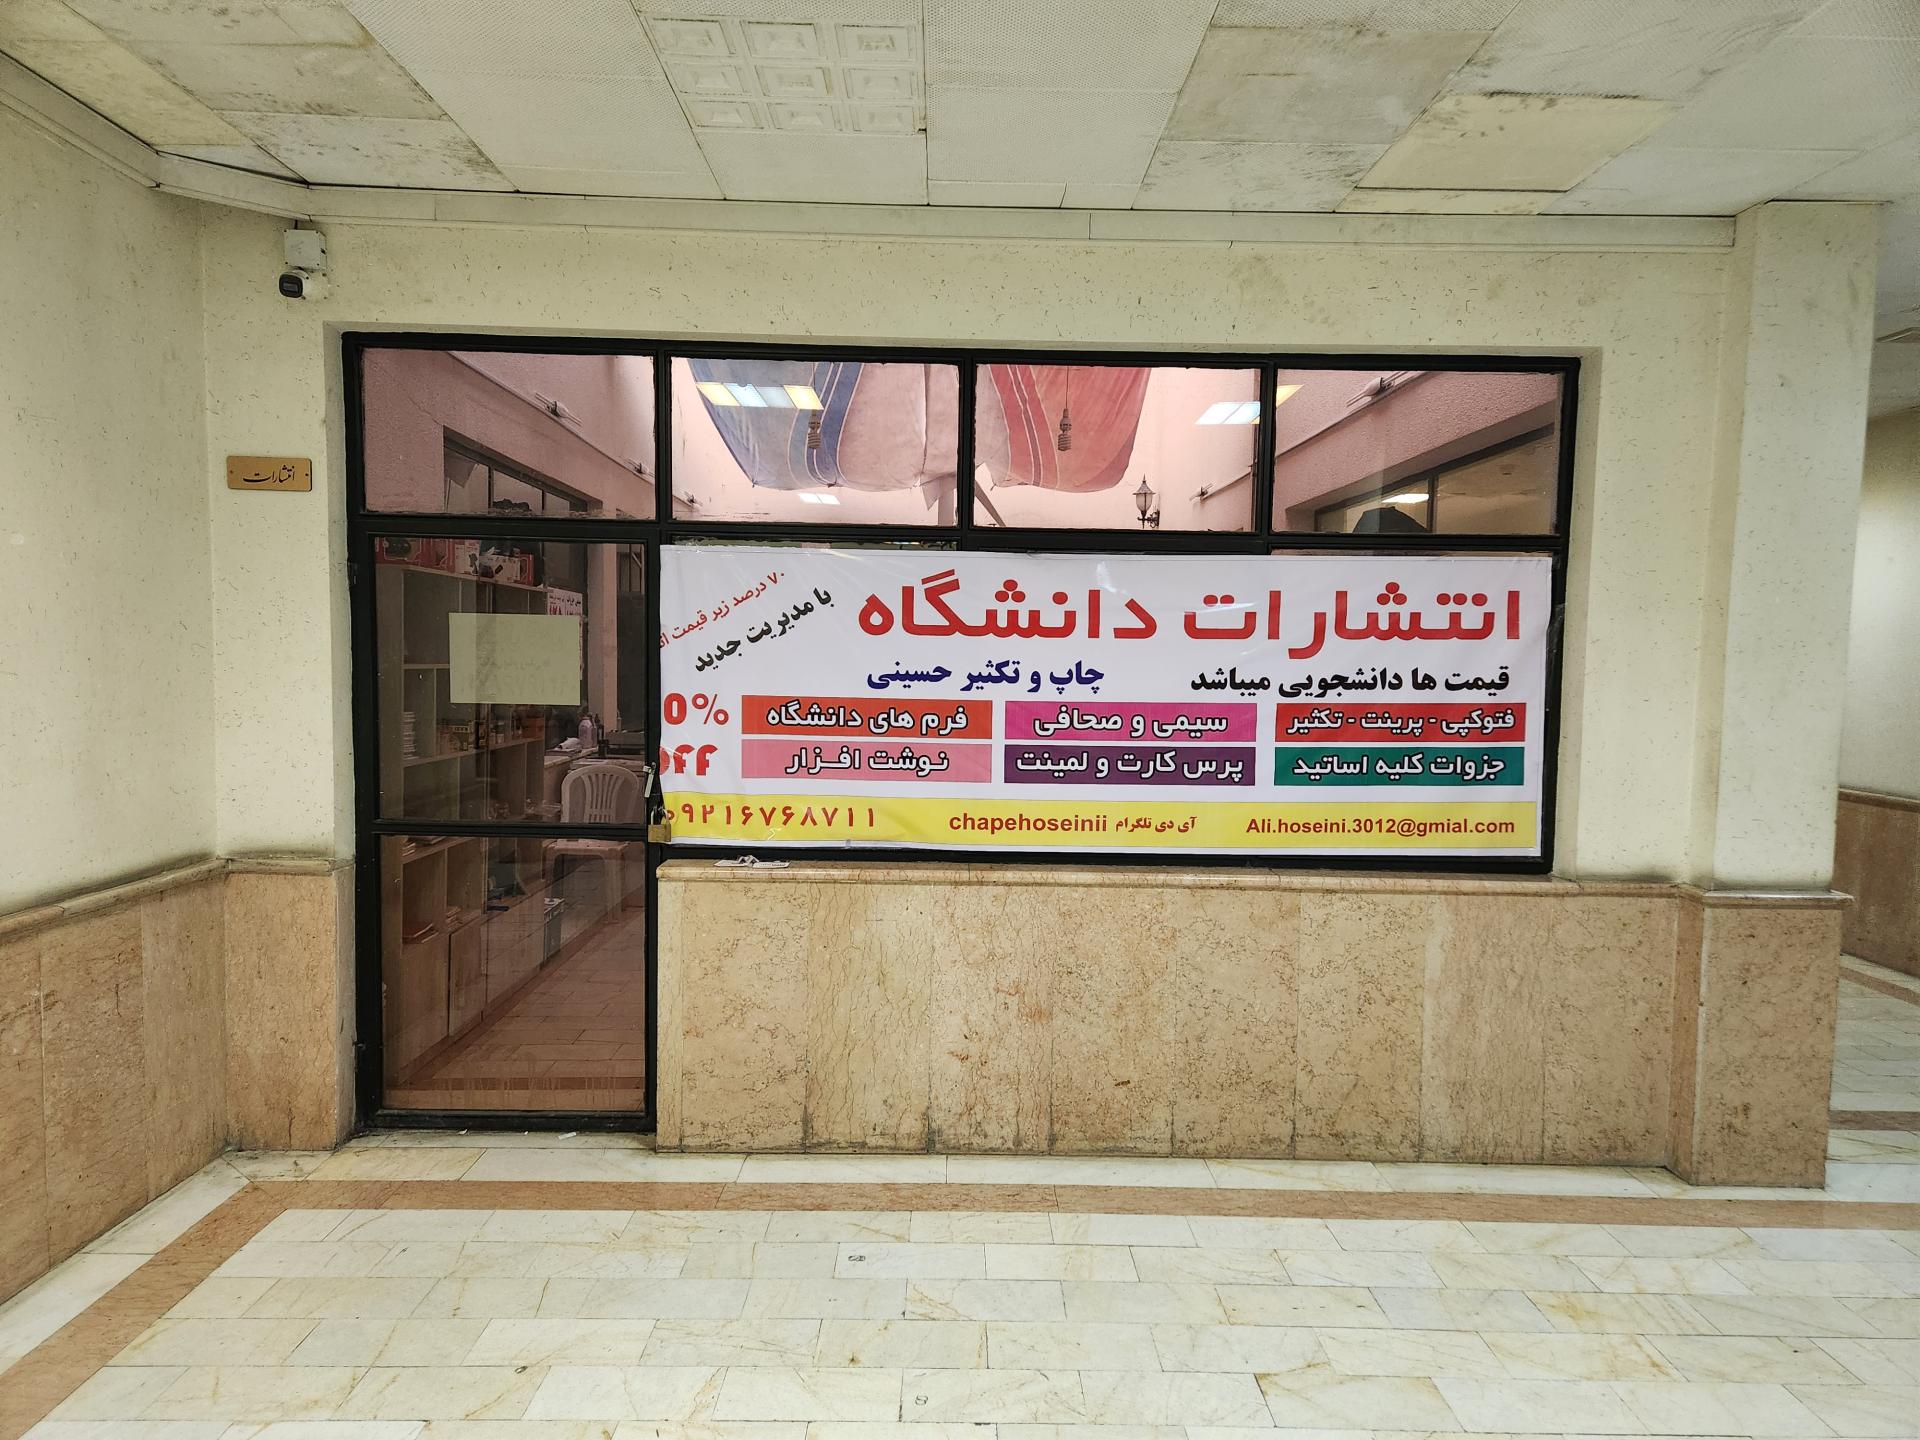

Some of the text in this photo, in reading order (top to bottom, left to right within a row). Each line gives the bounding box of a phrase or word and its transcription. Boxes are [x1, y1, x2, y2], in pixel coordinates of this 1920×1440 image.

[733, 582, 766, 606] درصد
[672, 610, 707, 639] قیمت
[712, 602, 730, 621] زیر
[858, 569, 1520, 659] انتشارات دانشگاه
[695, 587, 835, 672] با مدیریت جدید
[867, 659, 1104, 694] چاپ و تکثیر حسینی
[1191, 666, 1509, 698] قیمت ها دانشجویی میباشد
[767, 700, 968, 735] فرم های دانشگاه
[1034, 706, 1228, 738] سیمی و صحافی
[1286, 708, 1343, 735] تکثیر
[1360, 709, 1425, 737] پرینت
[1441, 708, 1515, 737] فتوکپی
[785, 746, 949, 777] نوشت افزار
[1016, 751, 1243, 782] پرس کارت و لمینت
[1293, 752, 1505, 781] جزوات کلیه اساتید
[949, 814, 1197, 835] آی دی تلگرام chapehoseinii
[1246, 818, 1515, 837] Ali.hoseini.3012@gmial.com
